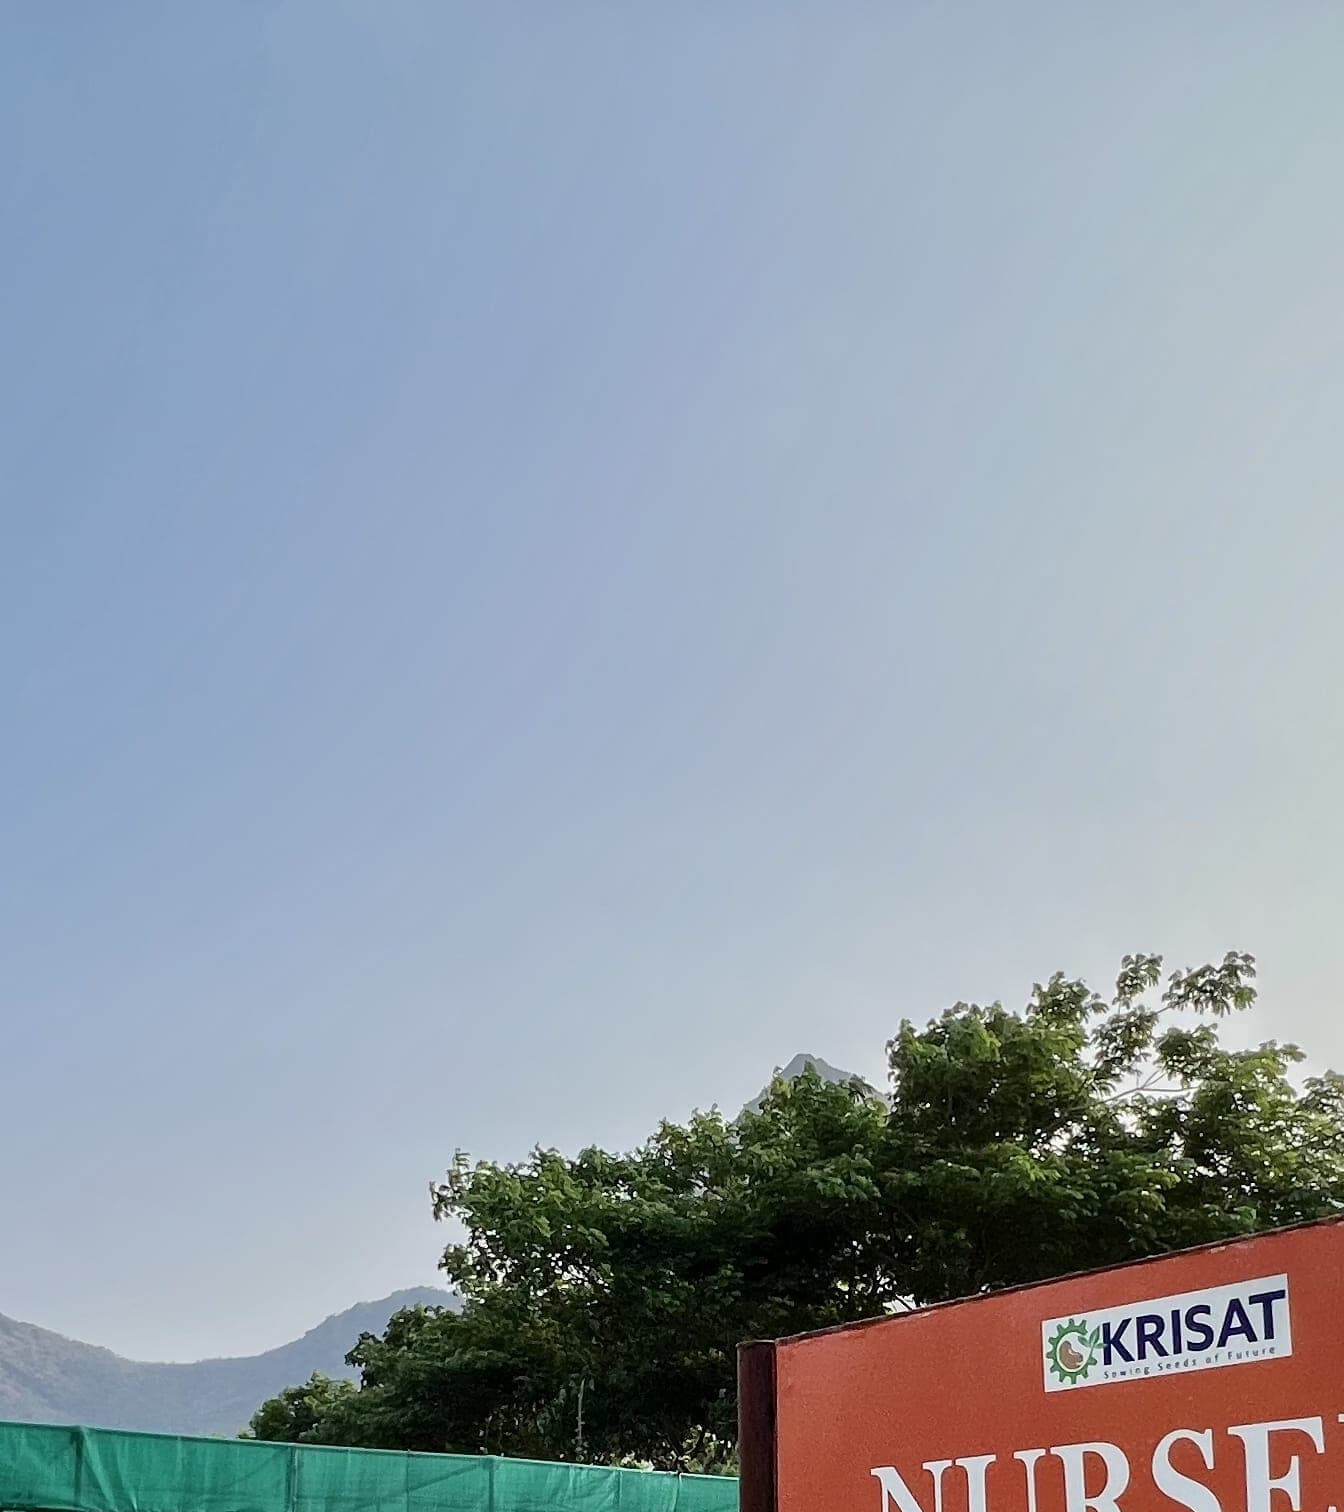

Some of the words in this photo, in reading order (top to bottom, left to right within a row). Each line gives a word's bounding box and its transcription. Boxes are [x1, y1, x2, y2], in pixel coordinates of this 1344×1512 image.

[1103, 1289, 1286, 1365] KRISAT
[1104, 1365, 1151, 1379] Sowing
[1157, 1357, 1197, 1372] Seeds
[1205, 1354, 1219, 1364] of
[1227, 1346, 1276, 1360] Future
